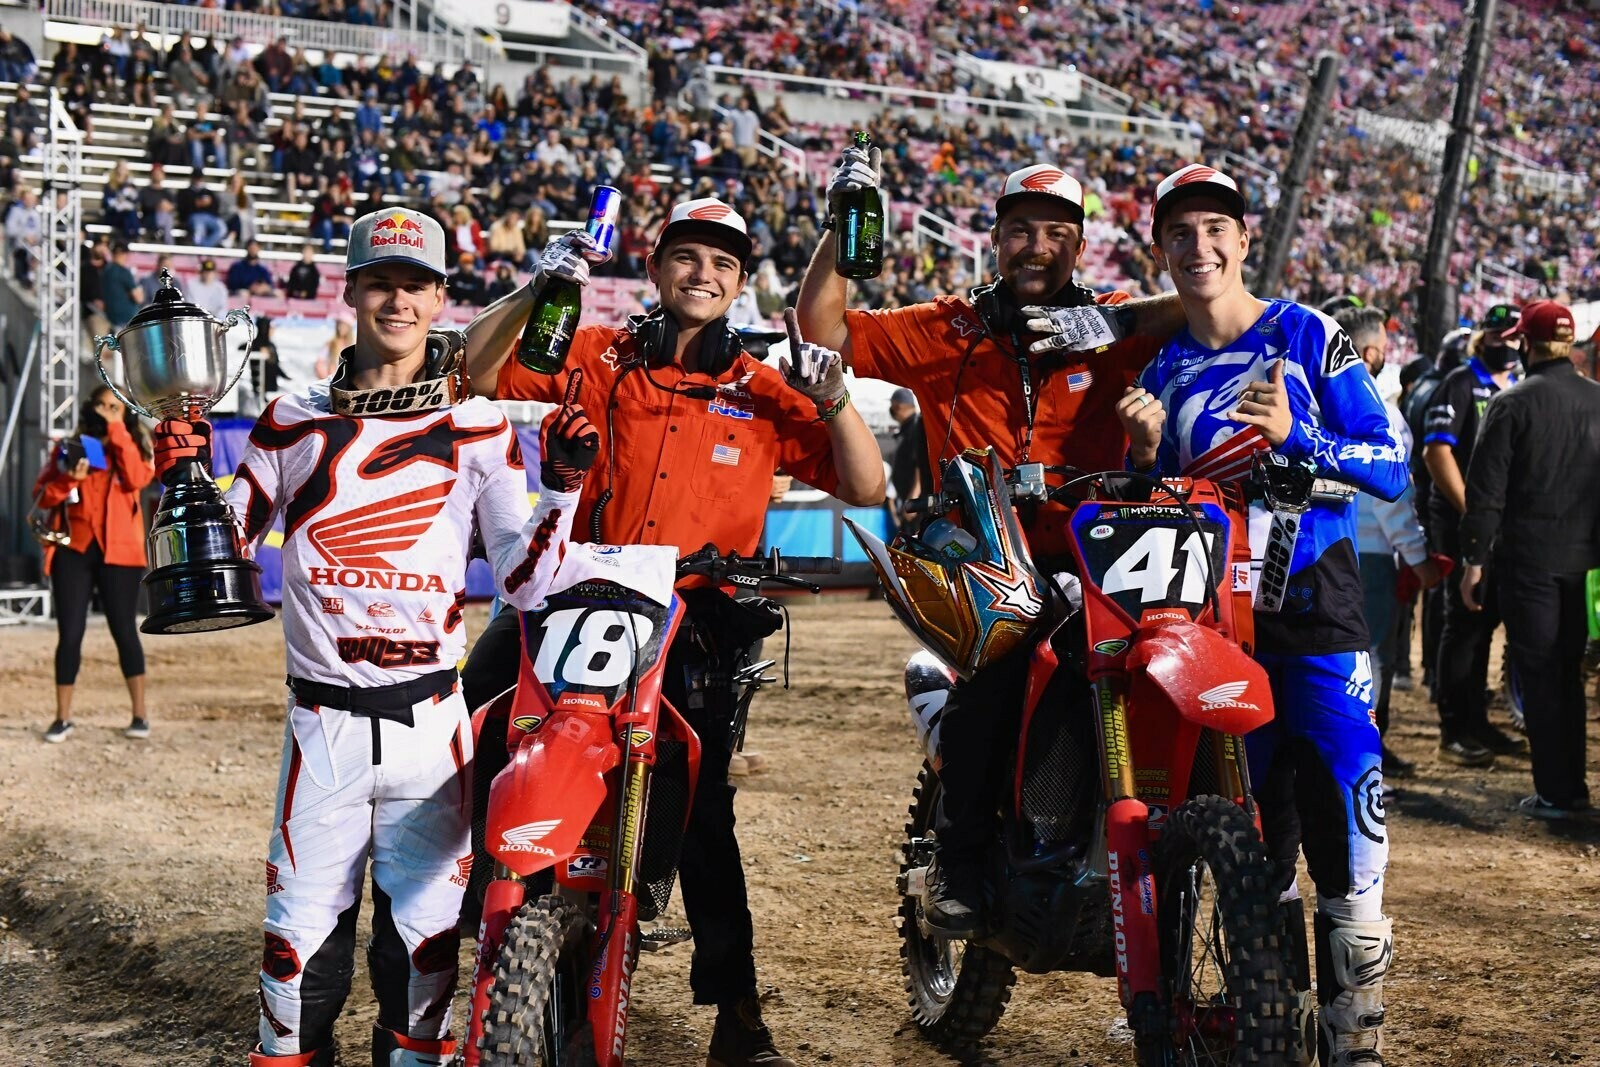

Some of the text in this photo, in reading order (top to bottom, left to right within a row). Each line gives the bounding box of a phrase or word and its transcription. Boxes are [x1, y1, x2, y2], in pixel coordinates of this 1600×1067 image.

[371, 233, 424, 249] Red Bull
[1130, 505, 1184, 516] MONSTER
[1101, 527, 1215, 604] 41
[308, 566, 447, 593] HONDA
[1146, 612, 1187, 622] HONDA
[532, 607, 654, 688] 18
[562, 698, 601, 708] HONDA
[1201, 701, 1261, 712] HONDA
[498, 844, 556, 857] HONDA
[1108, 850, 1128, 974] DUNLOP
[612, 932, 632, 1062] DUNLOP
